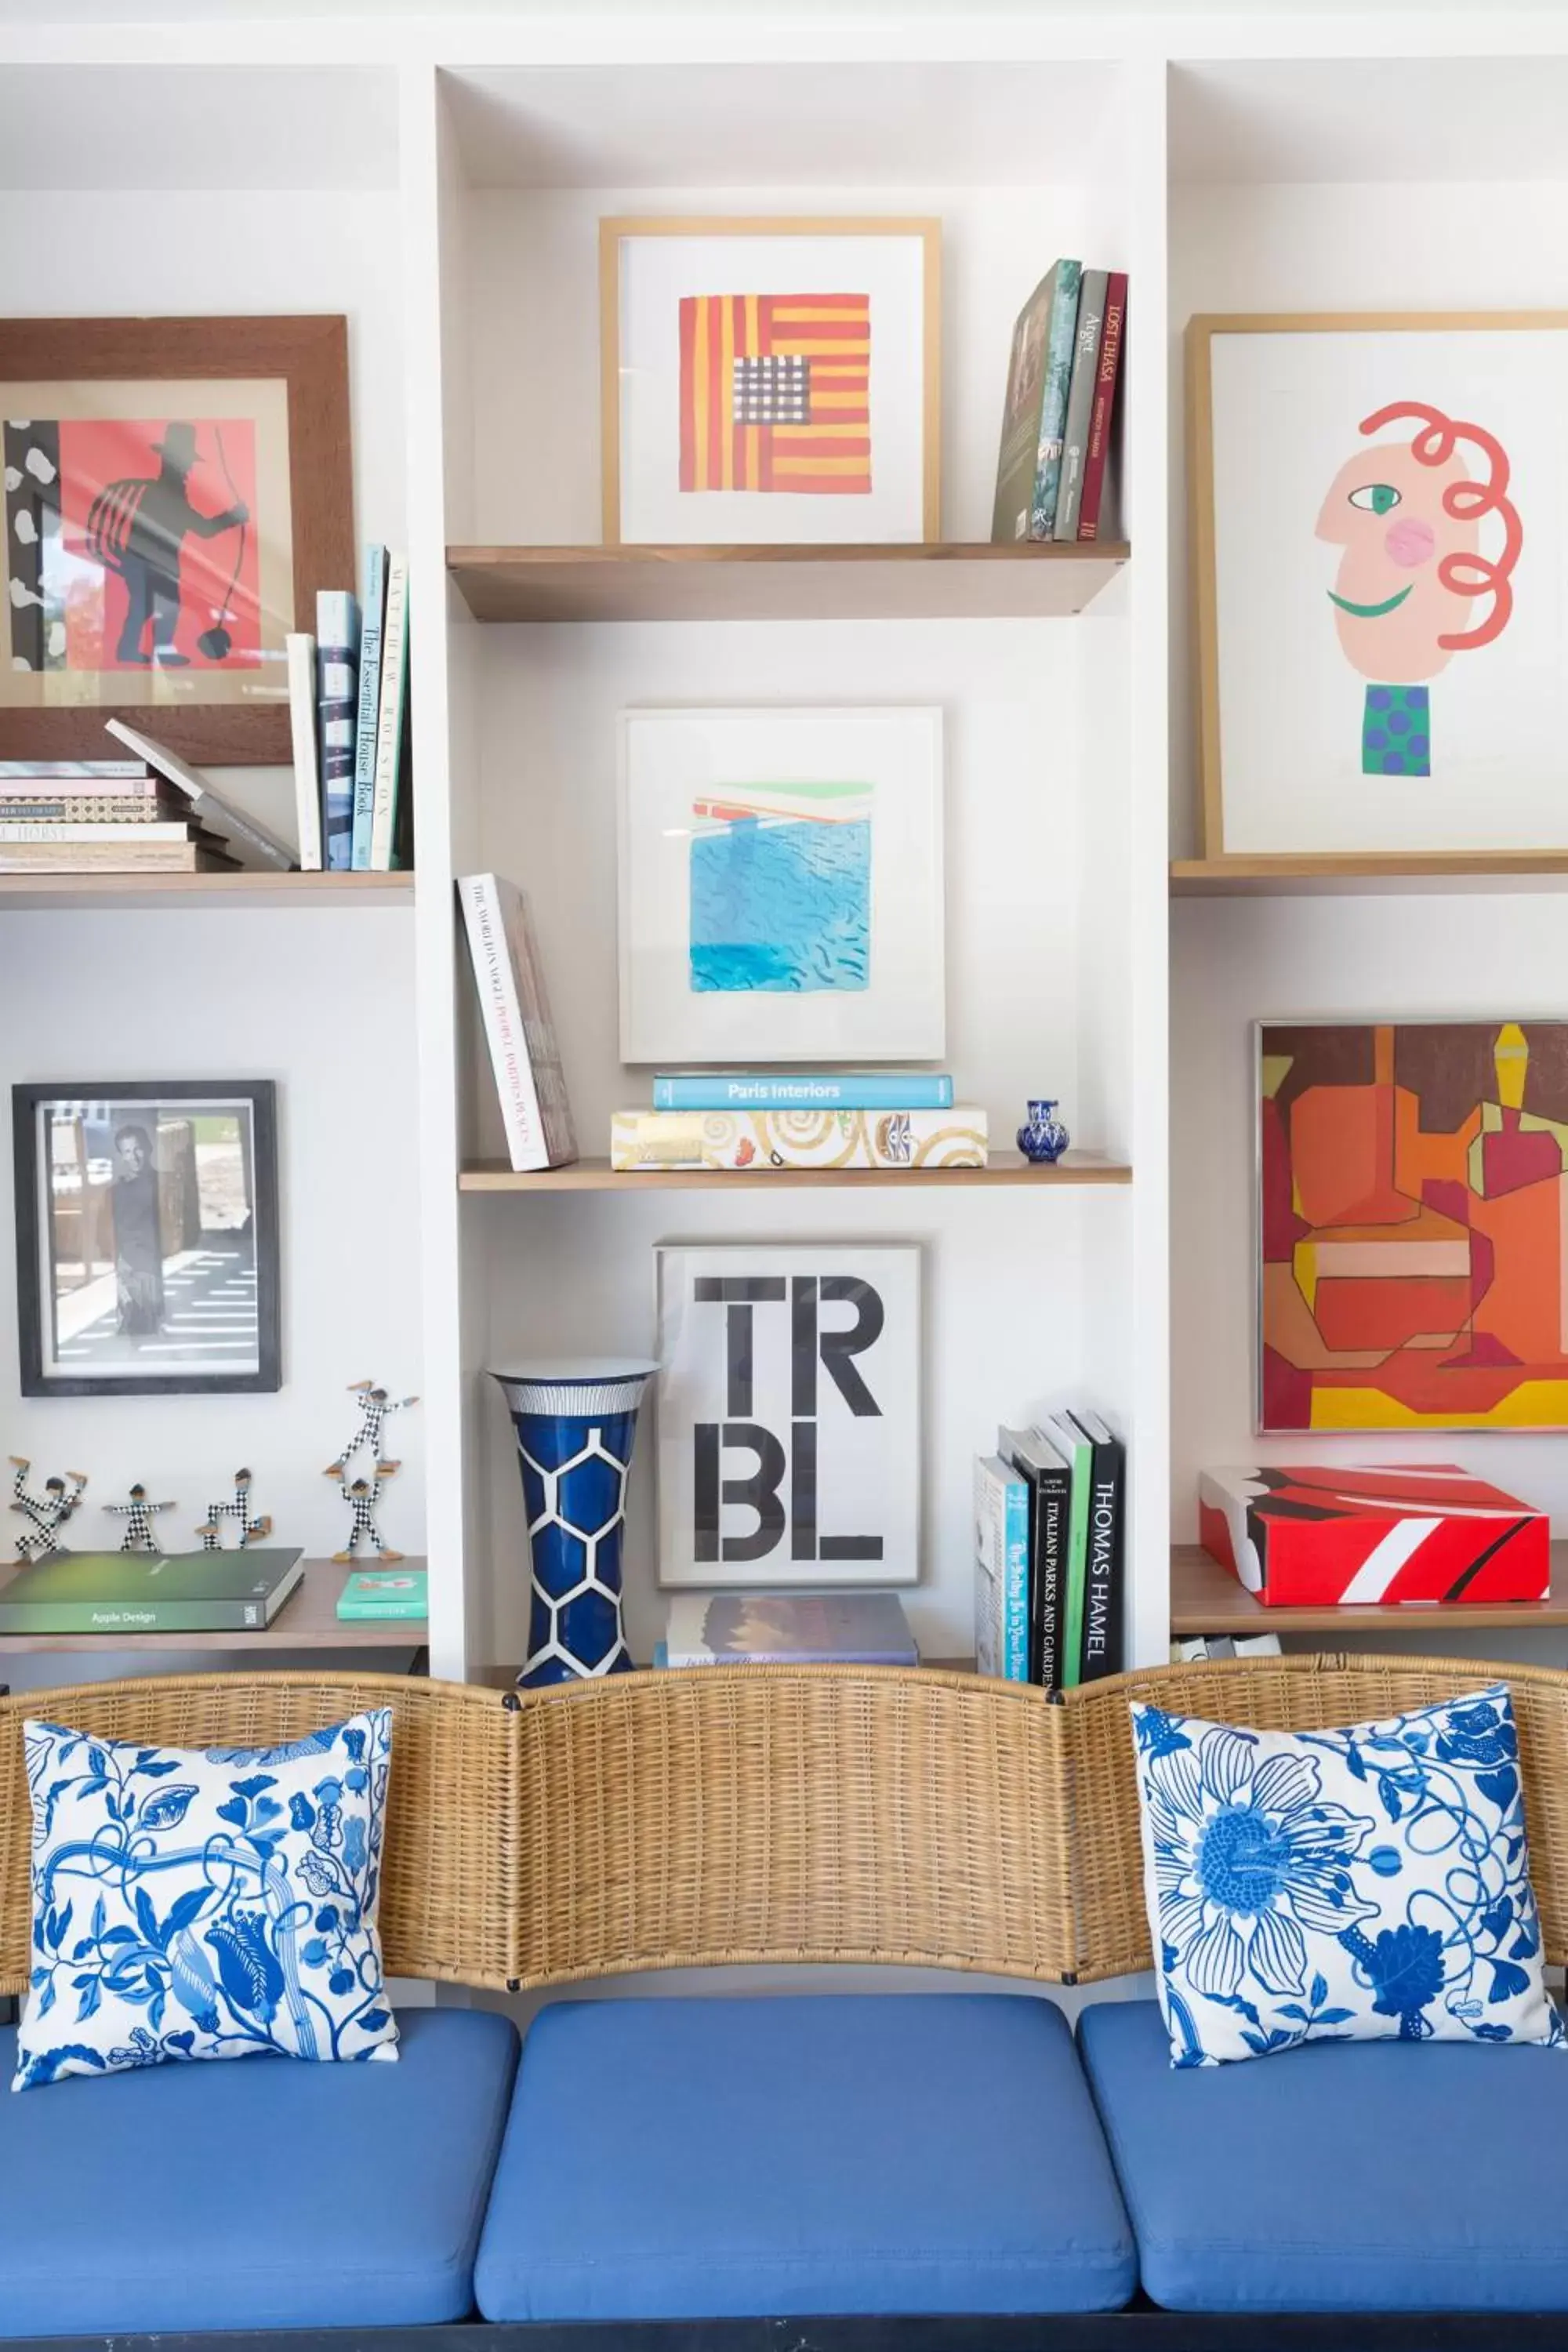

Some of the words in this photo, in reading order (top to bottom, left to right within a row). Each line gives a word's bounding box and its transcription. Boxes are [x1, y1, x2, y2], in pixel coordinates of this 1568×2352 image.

[1079, 313, 1102, 352] Atget
[1106, 306, 1121, 339] LOST
[1101, 341, 1117, 383] LHASA
[363, 627, 380, 655] The
[386, 568, 403, 682] MATTHEW
[360, 659, 379, 725] Essential
[358, 731, 376, 775] House
[378, 707, 394, 816] ROLSTON
[357, 782, 374, 816] Book
[728, 1083, 769, 1099] Paris
[771, 1083, 840, 1099] Interiors
[694, 1276, 884, 1417] TR
[694, 1421, 884, 1563] BL
[1047, 1501, 1059, 1555] ITALIAN
[1092, 1480, 1114, 1575] THOMAS
[1045, 1558, 1058, 1602] PARKS
[92, 1612, 120, 1625] Apple
[122, 1612, 157, 1625] Design
[1044, 1603, 1056, 1633] AND
[1087, 1583, 1109, 1661] HAMEL
